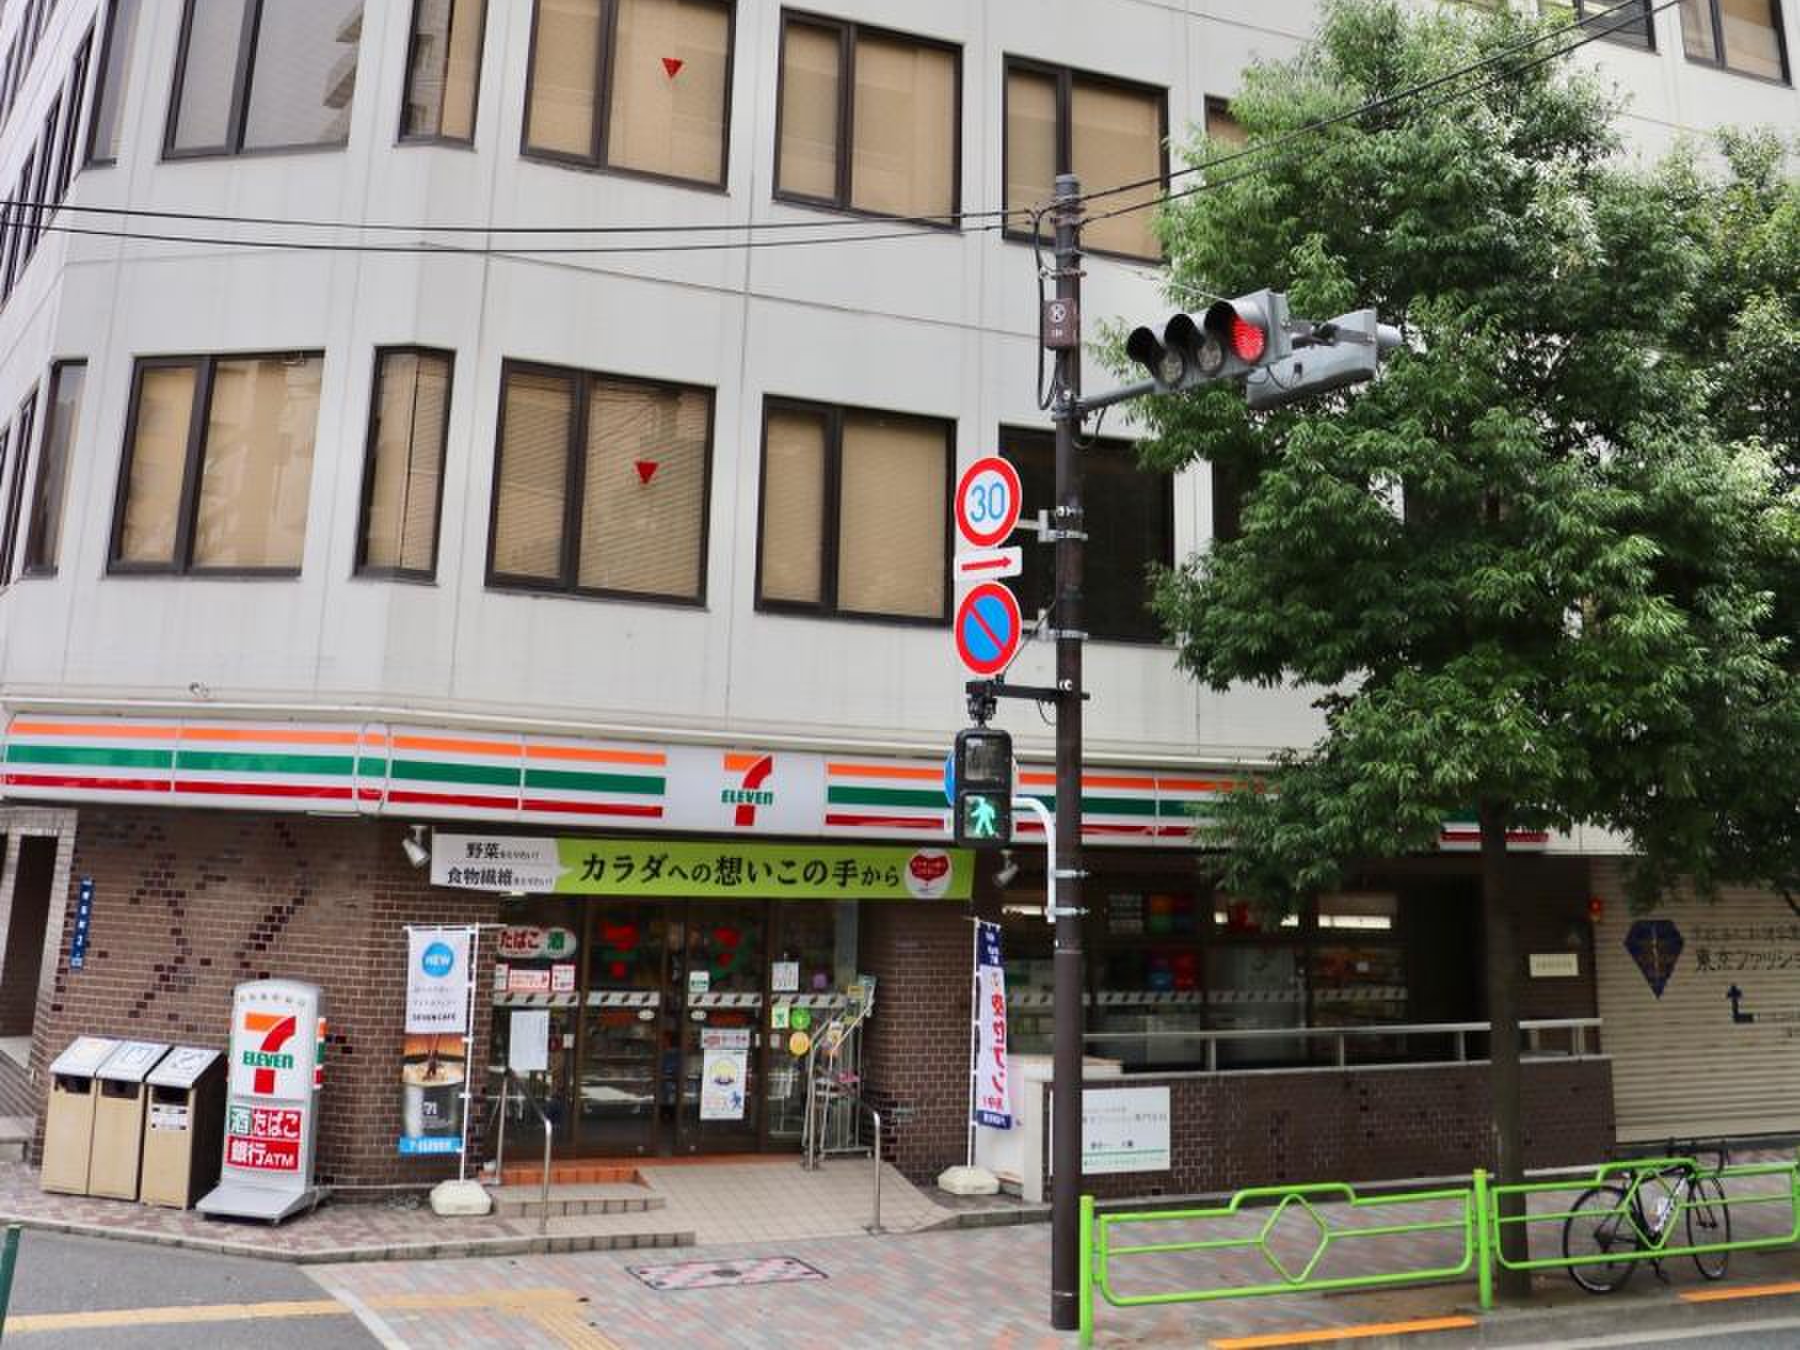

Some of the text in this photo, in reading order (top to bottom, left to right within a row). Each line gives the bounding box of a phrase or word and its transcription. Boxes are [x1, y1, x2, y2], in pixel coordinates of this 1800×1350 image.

[970, 482, 1006, 522] 30
[580, 853, 900, 888] カラダへの想いこの手から
[230, 1110, 299, 1139] 酒 たばこ
